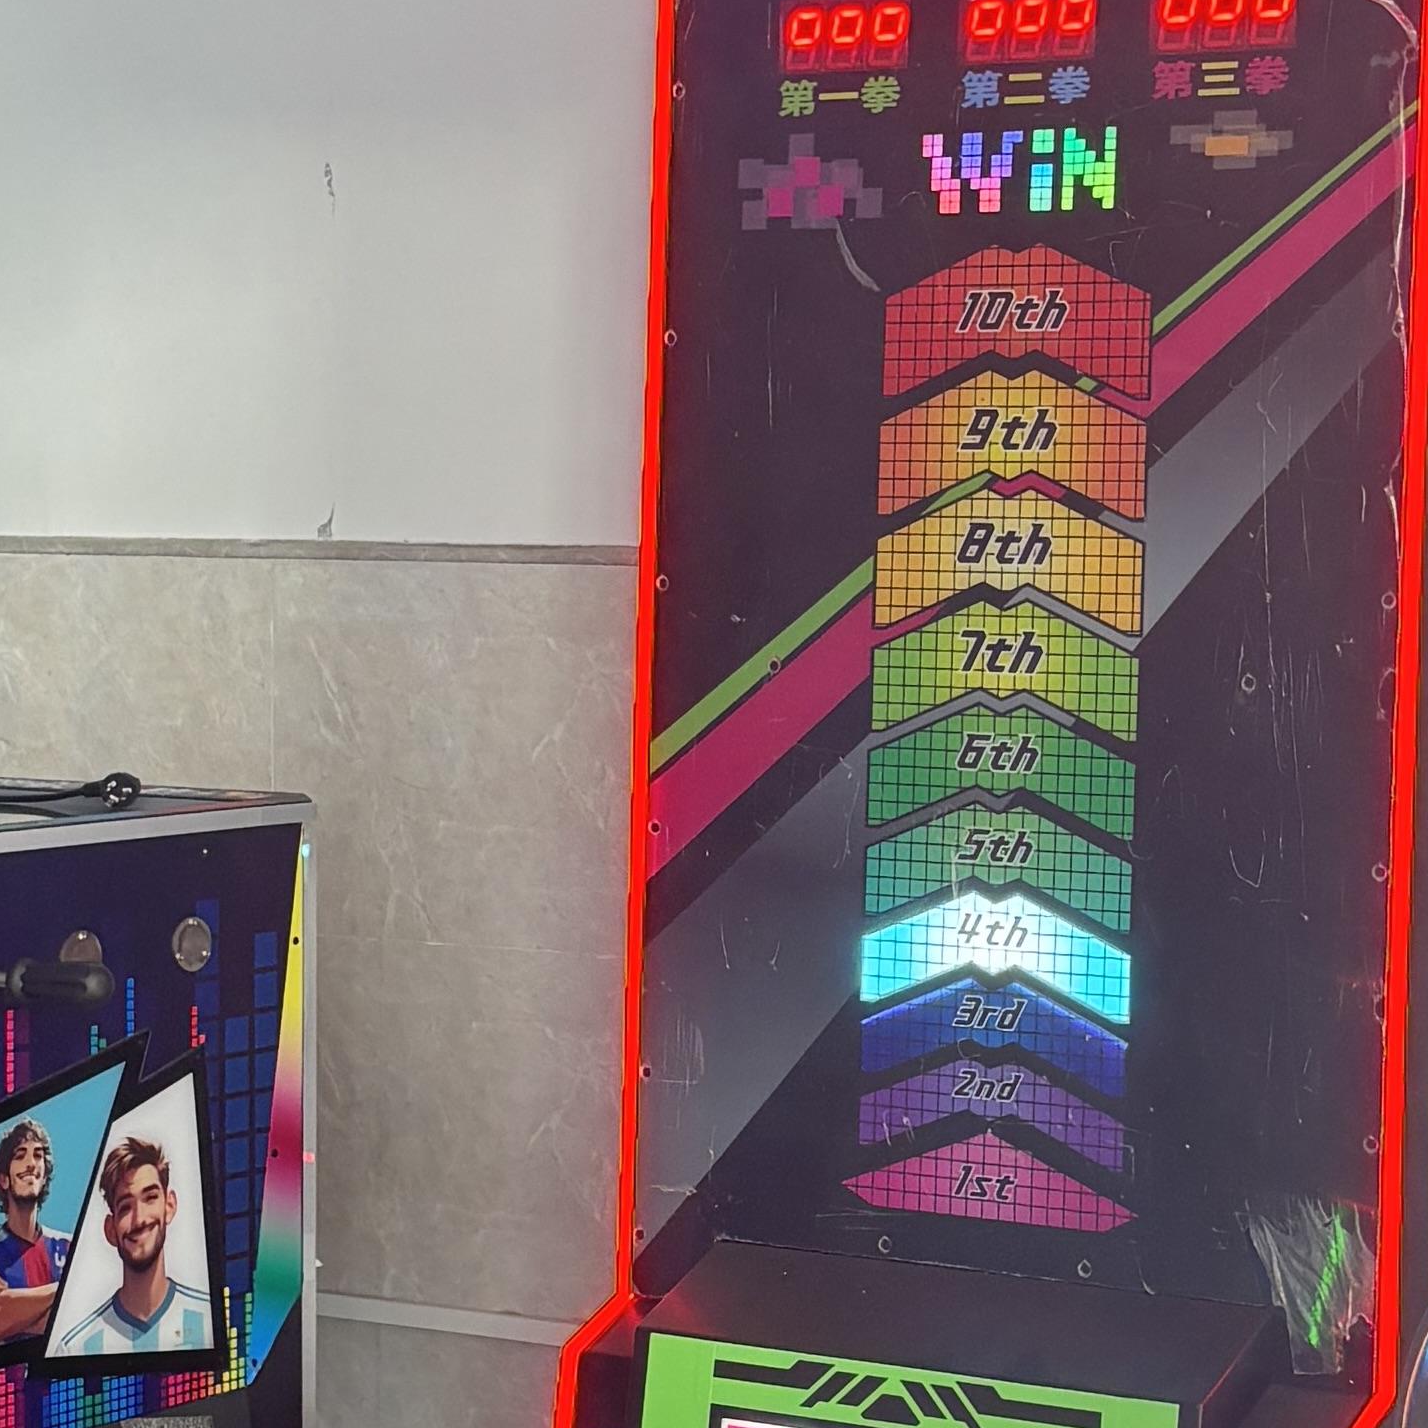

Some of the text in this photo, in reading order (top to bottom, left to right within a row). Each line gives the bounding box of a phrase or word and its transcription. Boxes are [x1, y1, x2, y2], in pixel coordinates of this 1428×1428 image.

[787, 4, 909, 49] 000
[778, 76, 900, 117] 第一拳
[962, 66, 1091, 108] 第二拳
[1152, 56, 1289, 100] 第三拳
[956, 288, 1070, 334] 10th
[958, 408, 1058, 451] 9th
[956, 522, 1053, 566] 8th
[959, 630, 1046, 675] 7th
[956, 733, 1041, 775] 6th
[958, 827, 1035, 866] 5th
[958, 912, 1030, 950] 4th
[952, 995, 1028, 1032] 3rd
[951, 1069, 1023, 1103] 2nd
[952, 1165, 1017, 1203] 1st
